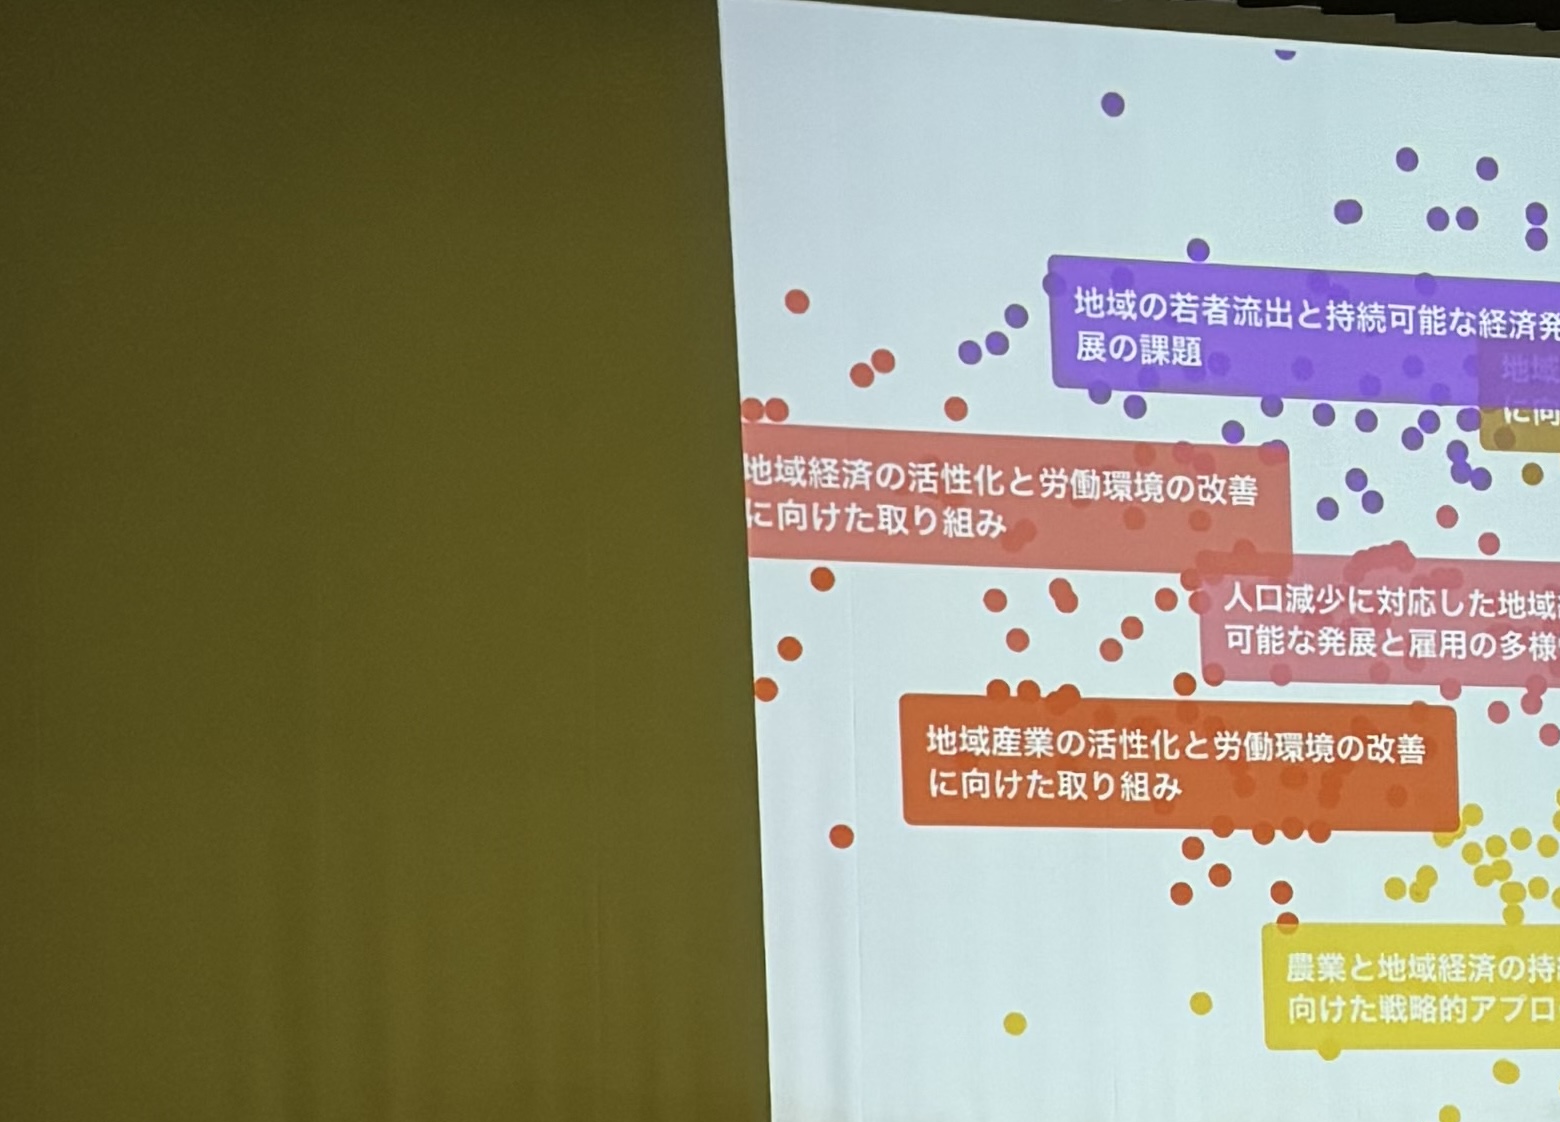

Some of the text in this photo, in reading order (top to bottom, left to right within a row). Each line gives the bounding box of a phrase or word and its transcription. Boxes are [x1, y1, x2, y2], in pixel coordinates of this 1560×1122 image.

[1076, 332, 1203, 367] 展の課題
[743, 453, 1259, 508] 地域経済の活性化と労働環境の改善
[745, 498, 1007, 539] に向けた取り組み
[926, 724, 1426, 767] 地域産業の活性化と労働環境の改善
[929, 768, 1183, 802] に向けた取り組み
